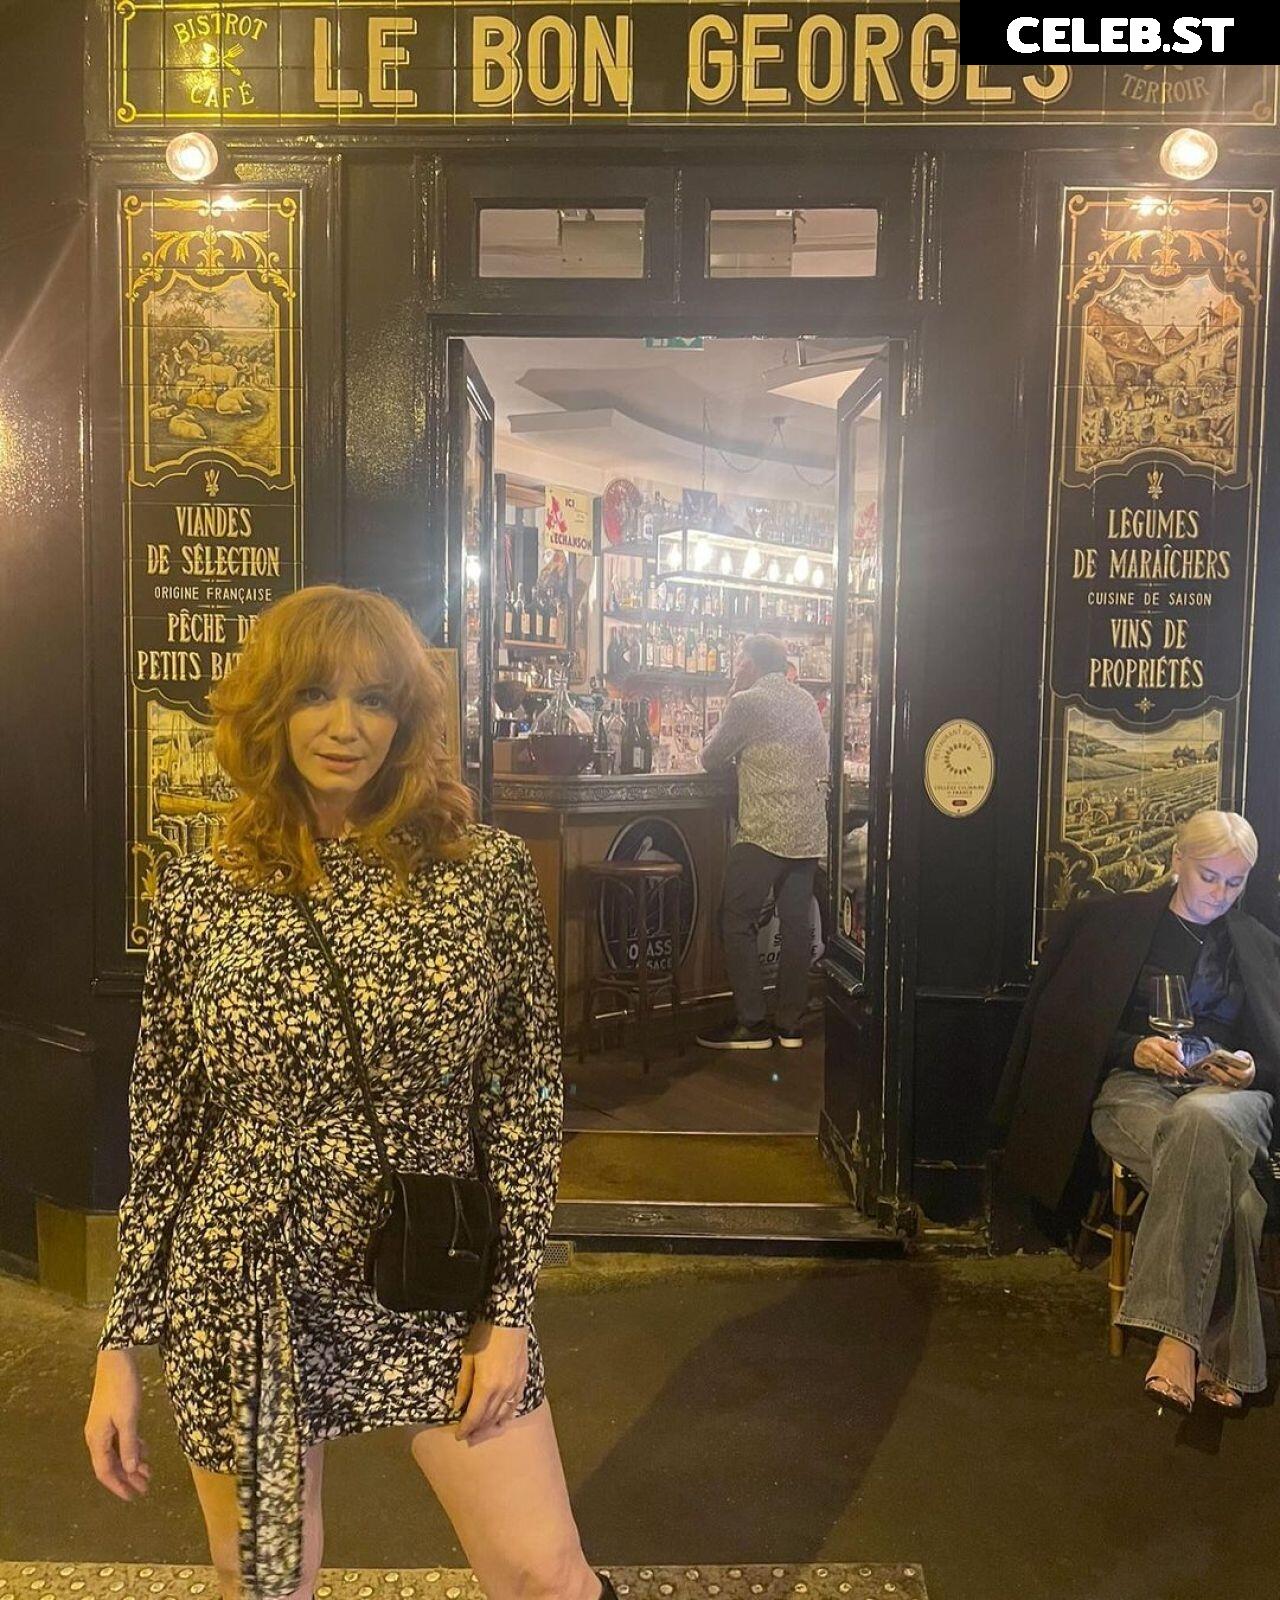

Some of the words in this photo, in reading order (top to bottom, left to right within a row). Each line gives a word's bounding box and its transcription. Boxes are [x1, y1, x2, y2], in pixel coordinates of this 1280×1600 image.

[173, 12, 268, 45] BISTROT
[313, 16, 417, 107] LE
[472, 14, 633, 107] BON
[190, 80, 255, 108] CAFÉ
[1120, 73, 1211, 105] TERROIR
[175, 505, 252, 538] VIANDES
[1107, 506, 1200, 539] LÉGUMES
[147, 544, 171, 576] DE
[181, 543, 281, 577] SÉLECTION
[1072, 548, 1098, 579] DE
[1109, 543, 1231, 580] MARAÎCHERS
[154, 585, 200, 600] ORIGINE
[206, 586, 273, 604] FRANÇAISE
[1087, 591, 1135, 606] CUISINE
[1144, 592, 1160, 606] DE
[1169, 592, 1212, 606] SAISON
[167, 608, 227, 644] PÊCHE
[1110, 618, 1153, 649] VINS
[1163, 618, 1190, 649] DE
[137, 650, 201, 682] PETITS
[1088, 655, 1205, 689] PROPRIÉTÉS
